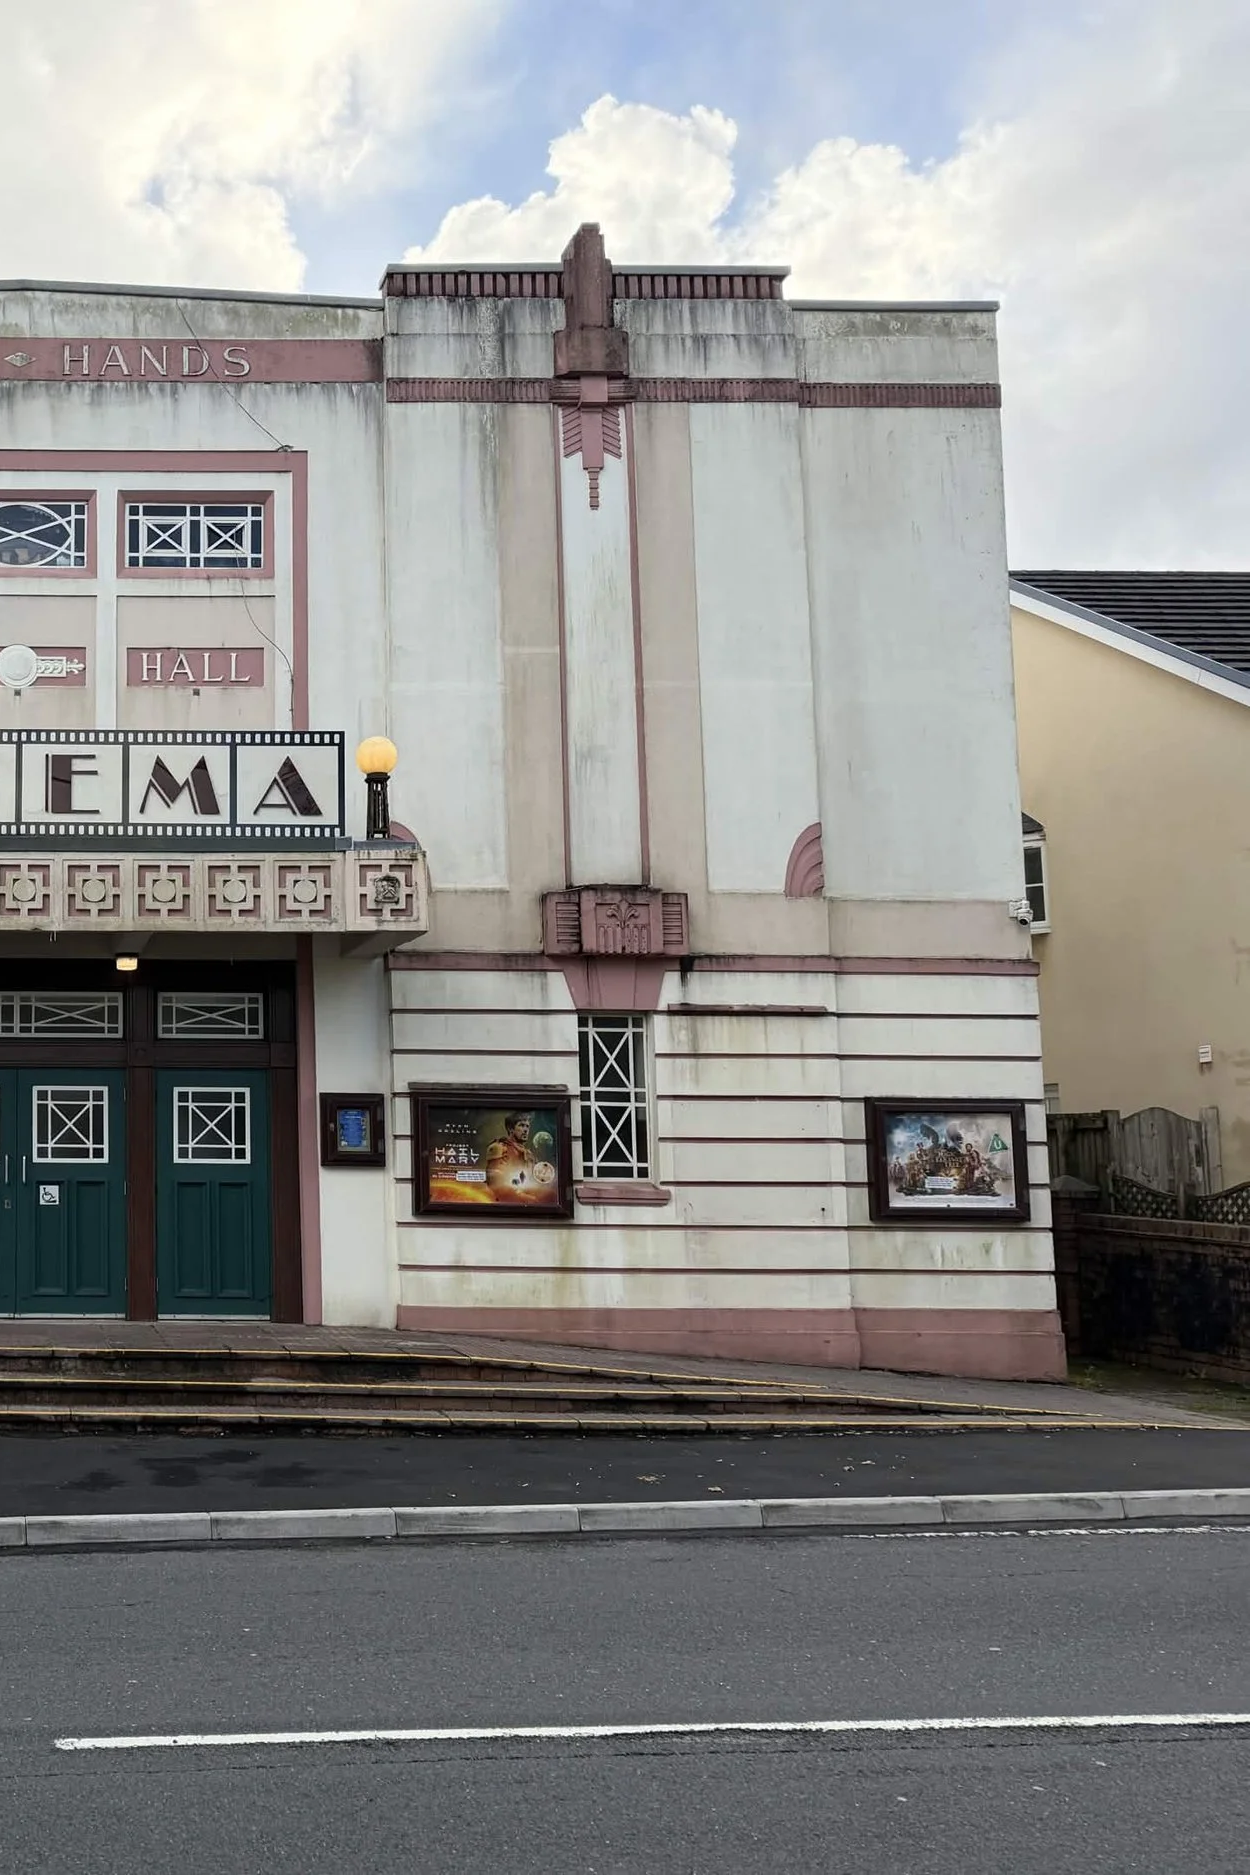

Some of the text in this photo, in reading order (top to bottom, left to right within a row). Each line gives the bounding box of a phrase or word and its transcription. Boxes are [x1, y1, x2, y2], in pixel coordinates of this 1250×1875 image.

[62, 344, 251, 378] HANDS
[140, 651, 251, 683] HALL
[994, 1139, 1001, 1150] U
[435, 1147, 480, 1156] HAIL
[435, 1155, 479, 1164] MARY
